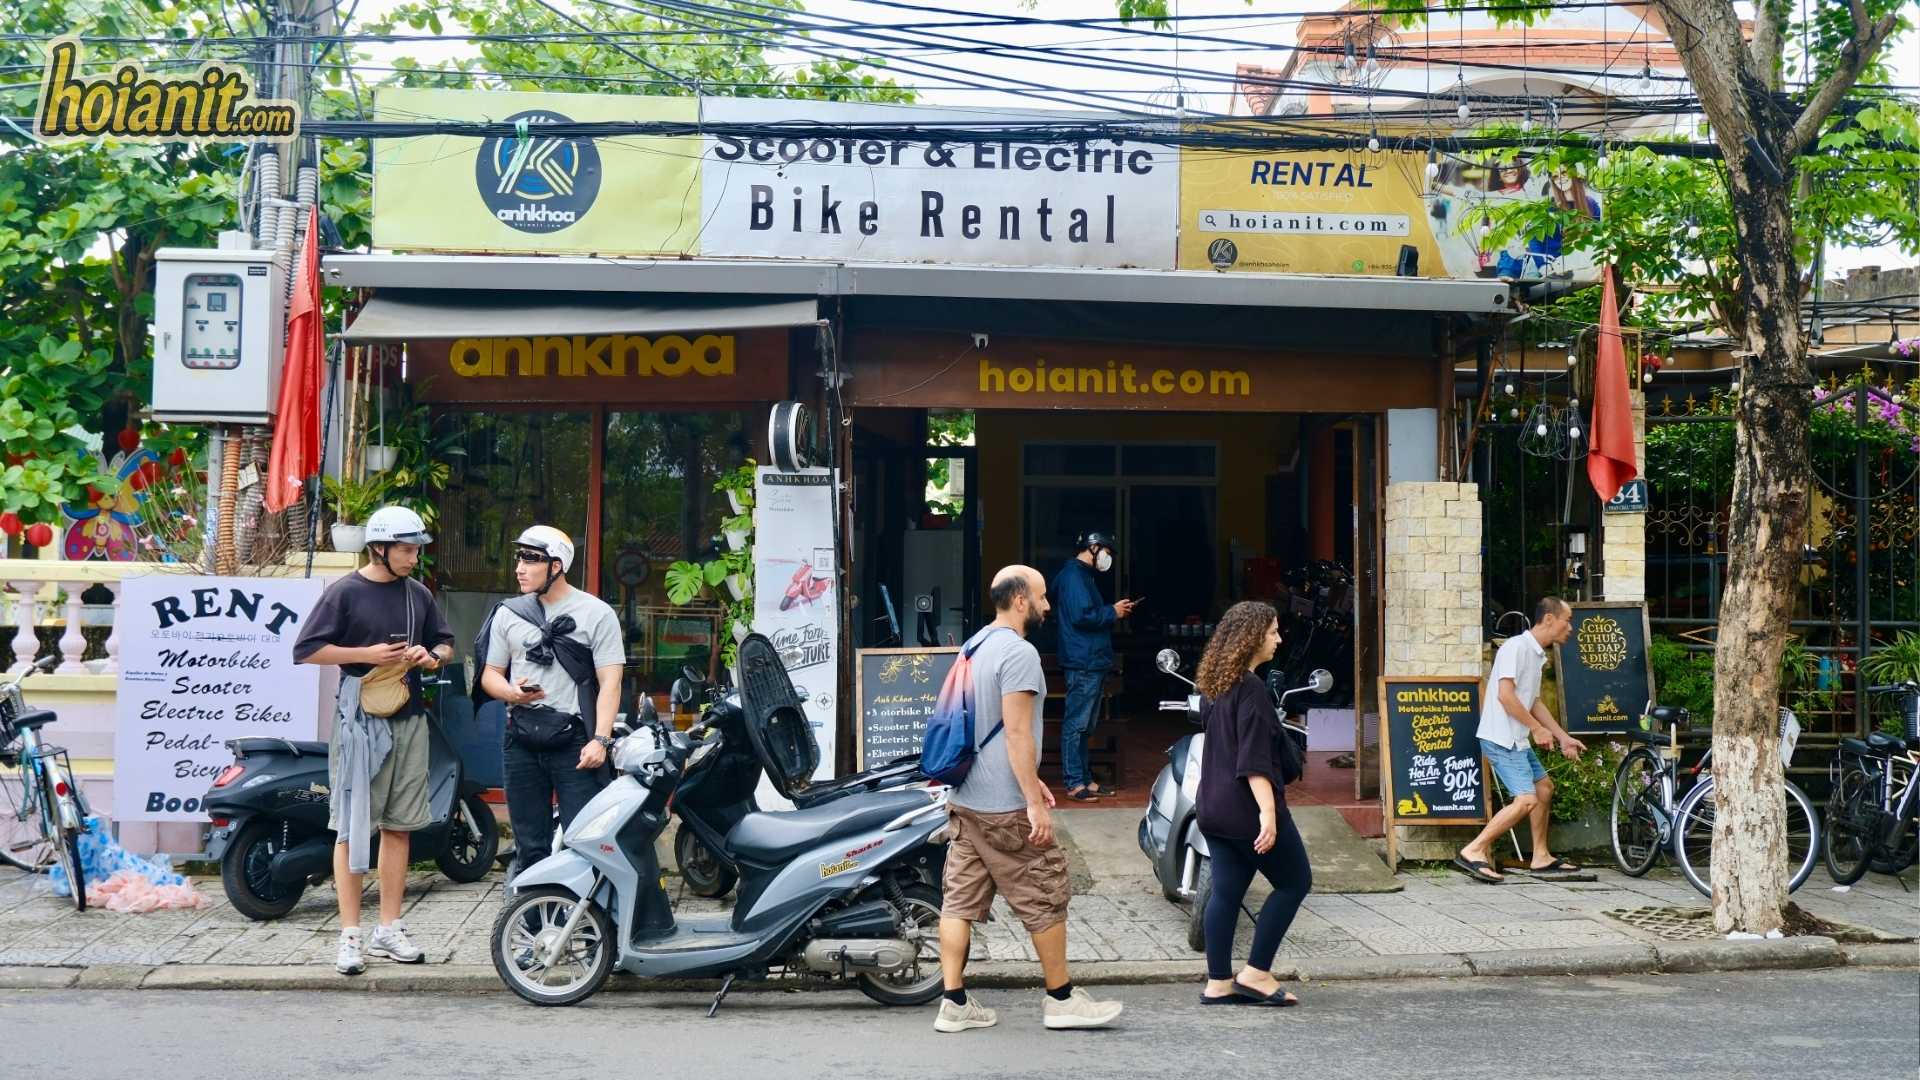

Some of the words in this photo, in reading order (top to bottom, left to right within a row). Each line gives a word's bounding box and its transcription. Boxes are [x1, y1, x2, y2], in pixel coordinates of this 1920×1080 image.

[715, 134, 908, 166] Scooter
[924, 138, 956, 168] &
[973, 139, 1153, 174] Electric
[1251, 160, 1373, 188] RENTAL
[497, 203, 576, 222] anhkhoa
[750, 184, 879, 236] Bike
[920, 190, 1115, 244] Rental
[1229, 214, 1388, 232] hoianit.com
[979, 360, 1250, 395] hoianit.com
[766, 475, 828, 484] ANHKHOA
[152, 588, 298, 635] RENT
[1588, 624, 1612, 633] CHO
[1584, 632, 1618, 643] THUÊ
[1580, 644, 1594, 652] XE
[158, 648, 271, 670] Motorbike
[171, 676, 252, 695] Scooter
[1396, 688, 1471, 702] anhkhoa
[141, 700, 224, 720] Electric
[235, 703, 293, 722] Bikes
[1398, 705, 1441, 713] Motorbike
[1442, 705, 1470, 713] Rental
[1412, 714, 1450, 728] Electric
[1587, 714, 1628, 722] hoianit.com
[872, 723, 910, 732] Scooter
[1413, 726, 1454, 742] Scooter
[872, 735, 910, 744] Electric
[1416, 738, 1452, 753] Rental
[872, 749, 909, 758] Electric
[1412, 755, 1437, 768] Ride
[1443, 756, 1476, 774] From
[1408, 767, 1426, 780] Hoi
[1426, 765, 1440, 778] An
[1443, 768, 1480, 792] 90K
[1452, 788, 1476, 802] day
